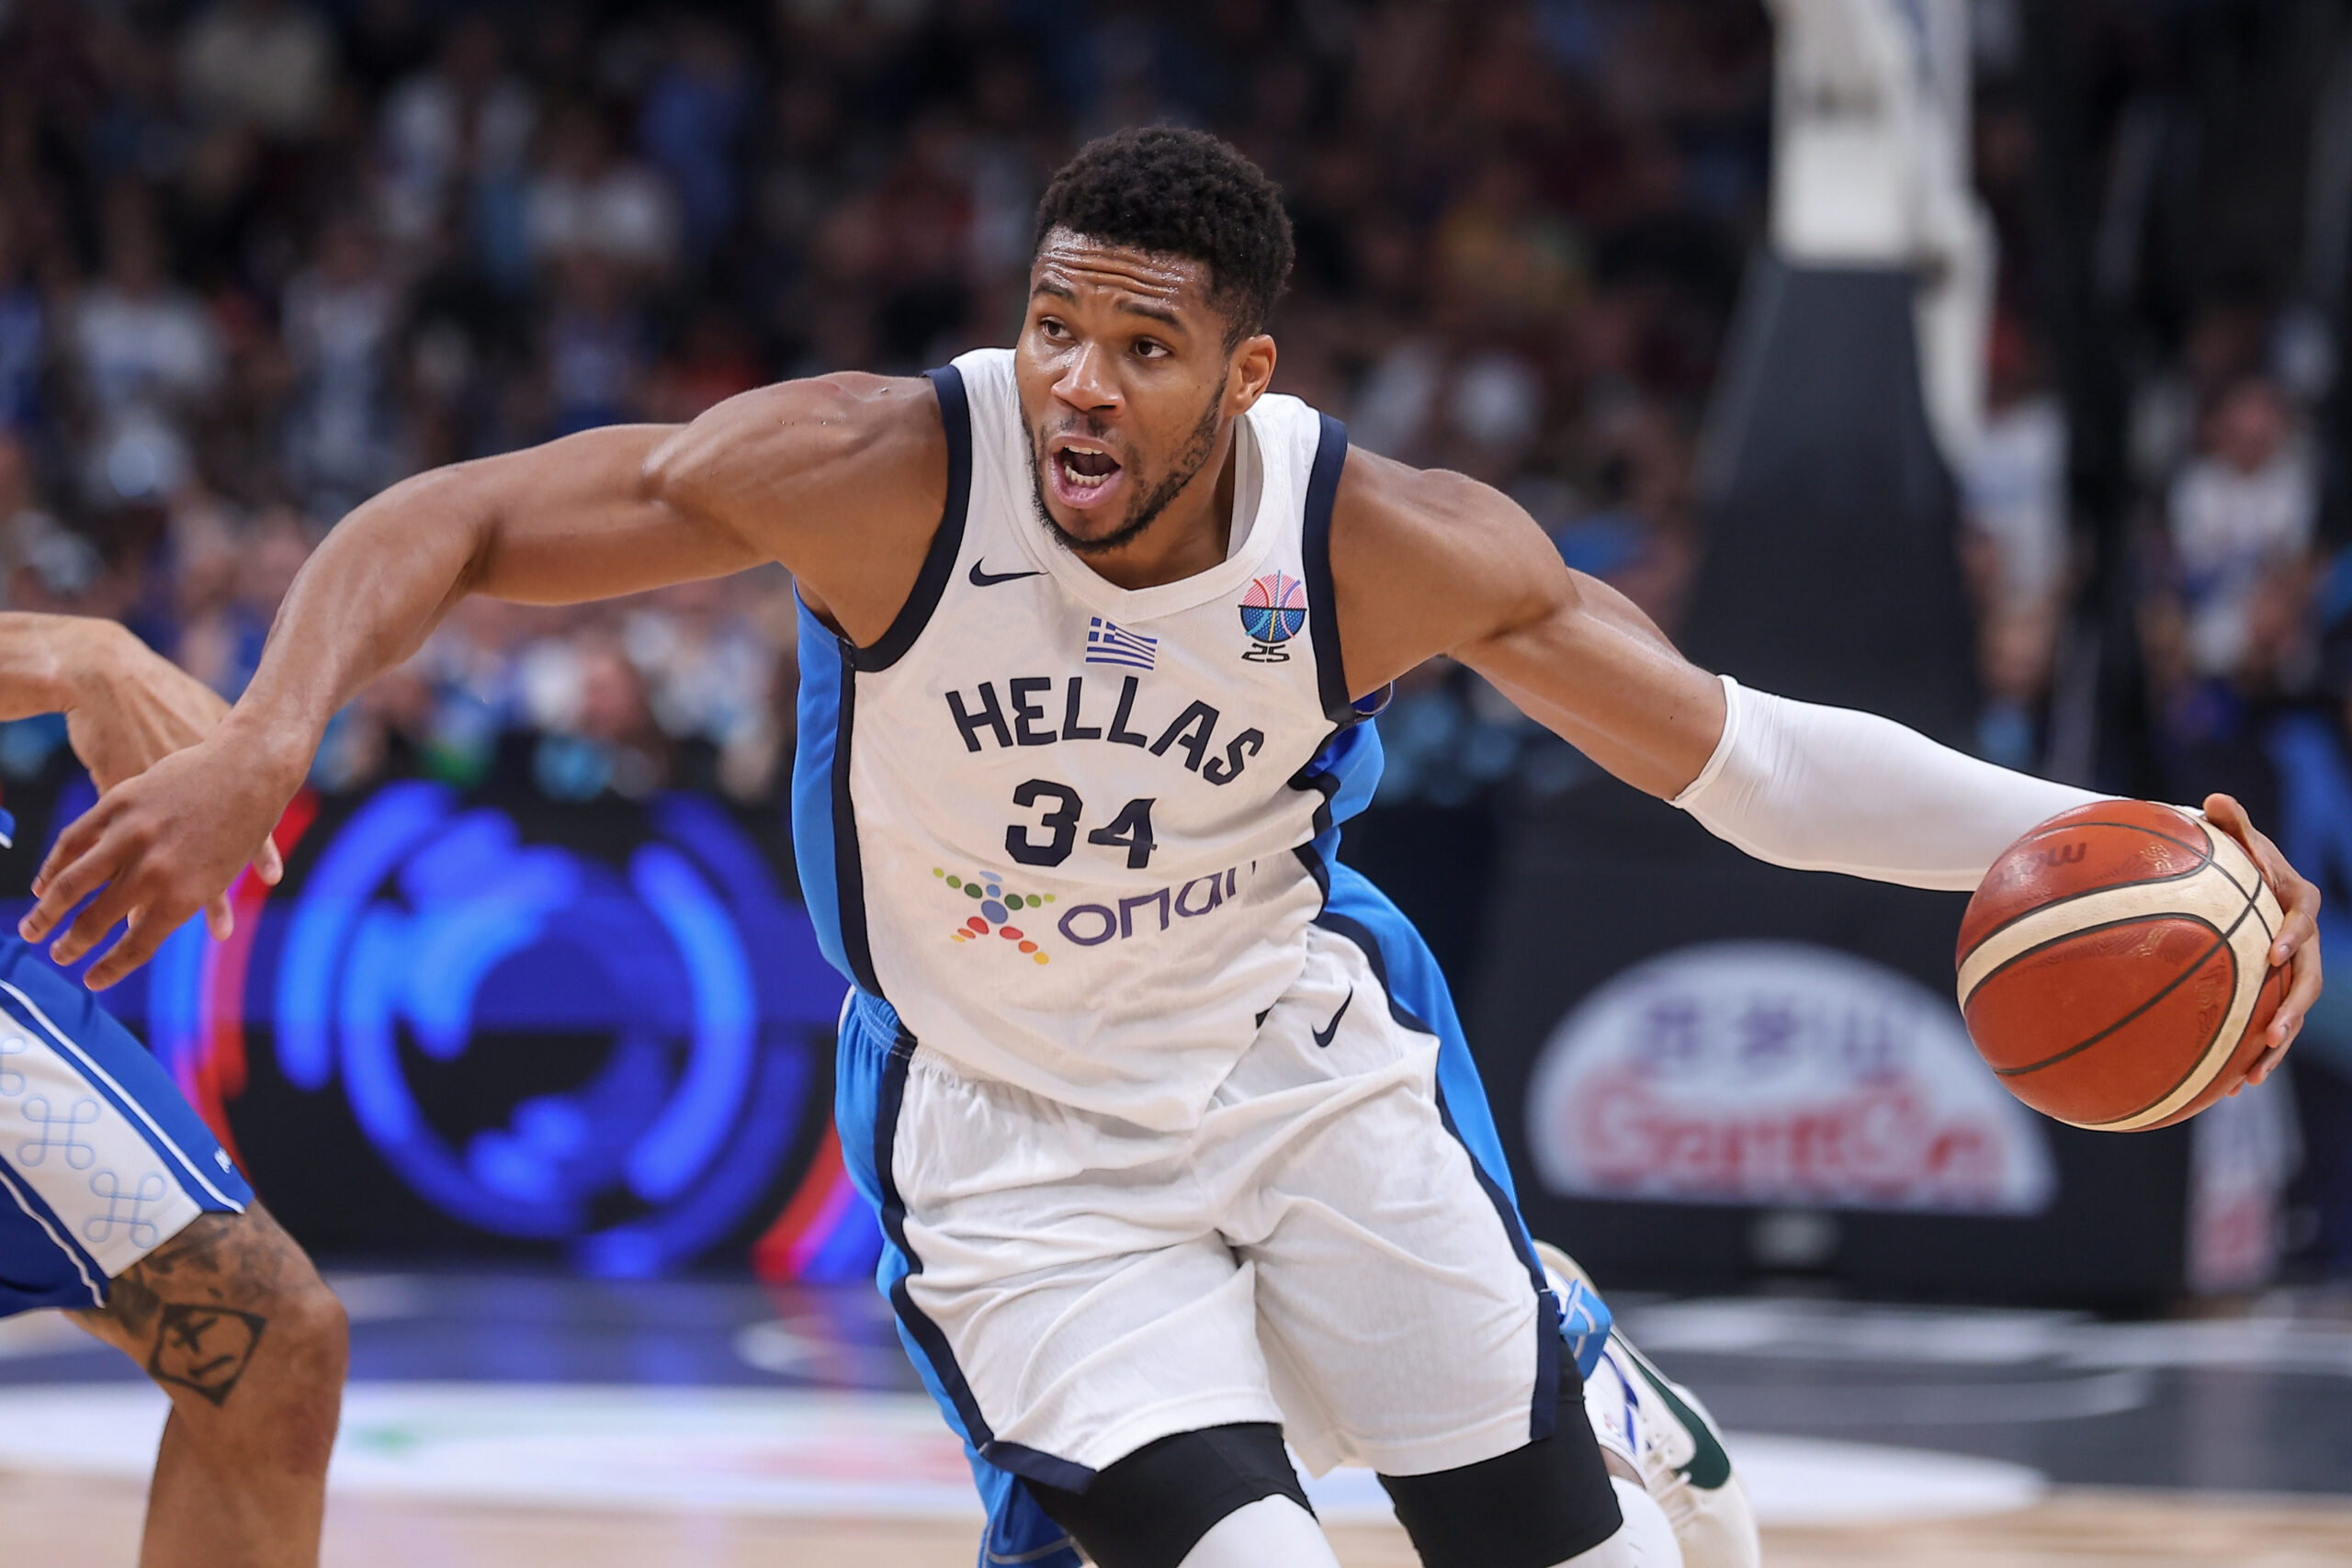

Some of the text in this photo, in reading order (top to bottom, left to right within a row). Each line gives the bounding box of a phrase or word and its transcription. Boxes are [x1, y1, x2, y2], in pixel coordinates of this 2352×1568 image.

[1241, 643, 1290, 662] 25
[945, 676, 1264, 785] HELLAS
[1005, 779, 1158, 868] 34
